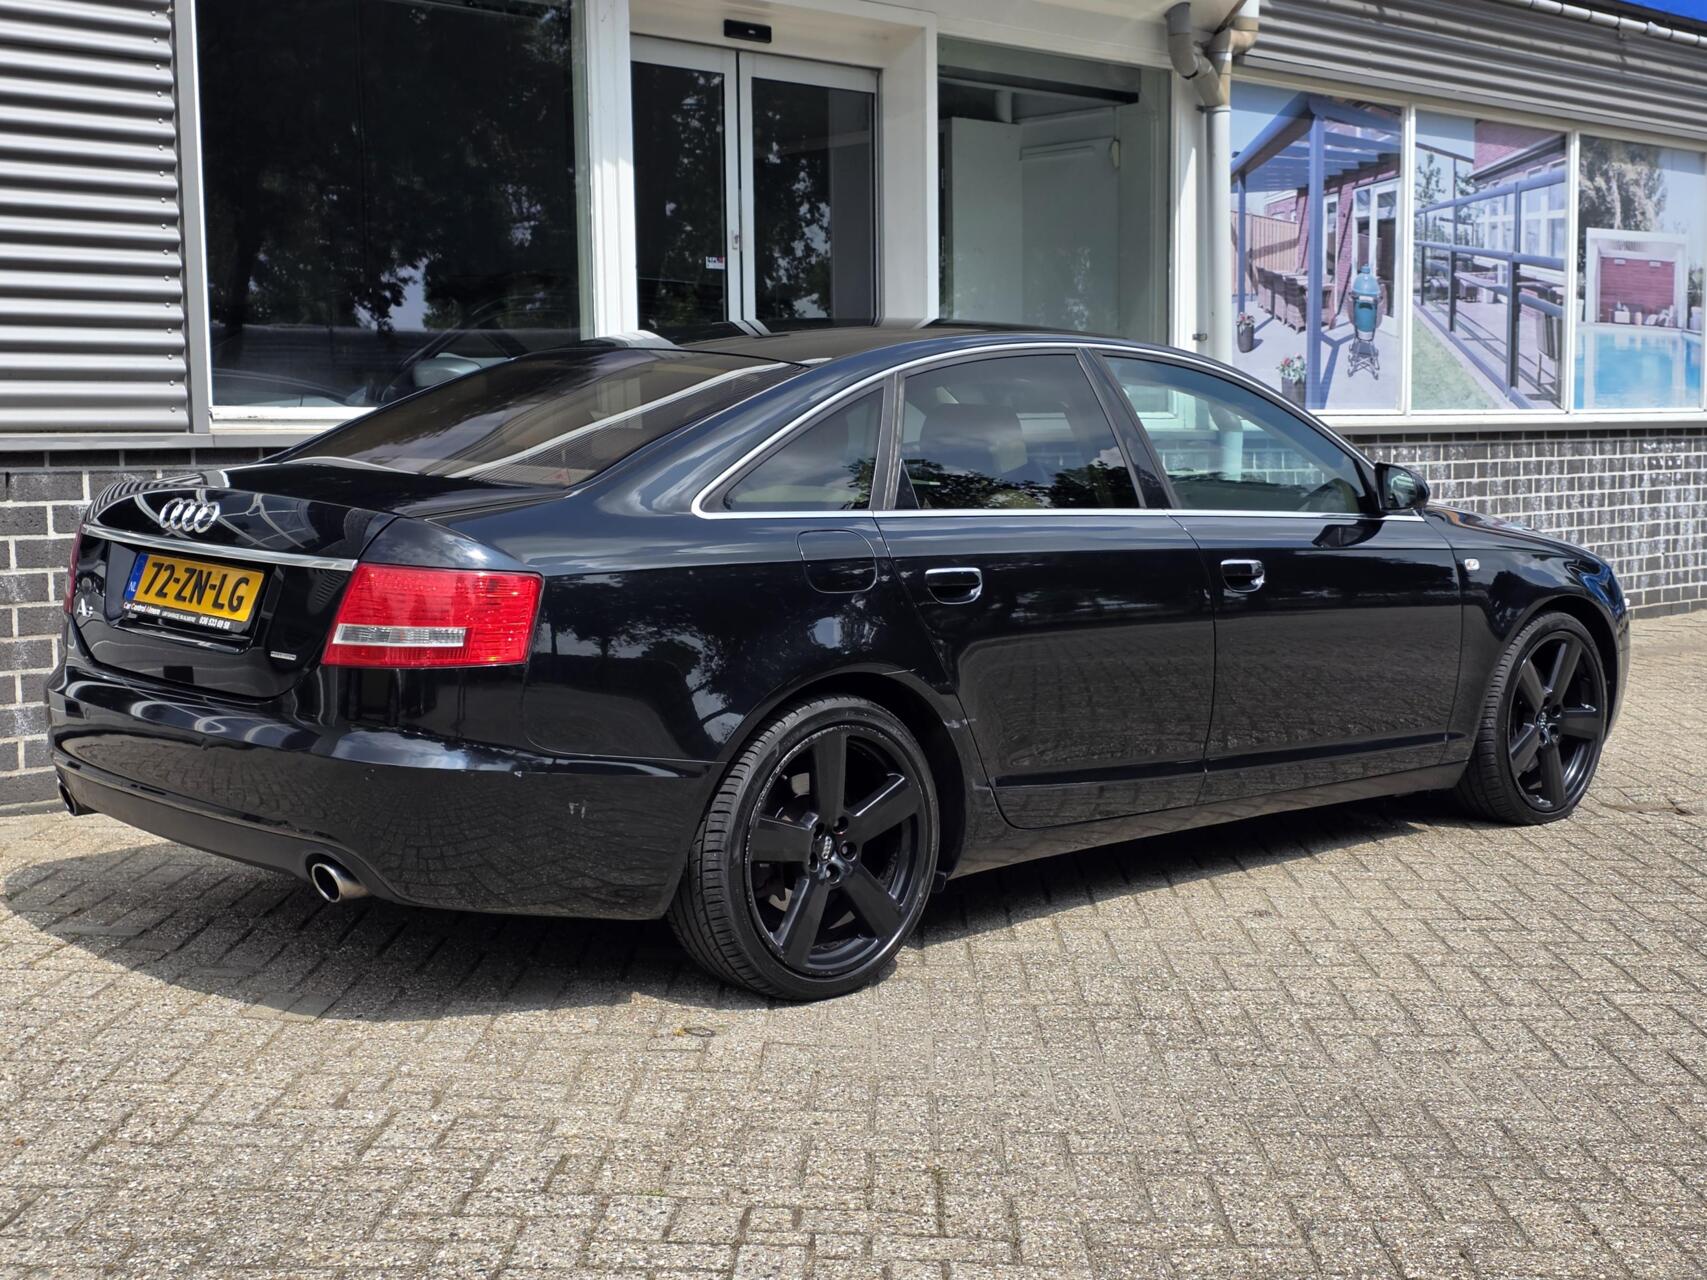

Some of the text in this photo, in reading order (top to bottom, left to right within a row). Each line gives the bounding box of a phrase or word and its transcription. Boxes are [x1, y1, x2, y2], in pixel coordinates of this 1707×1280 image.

[128, 581, 136, 593] NL
[143, 562, 250, 613] 72-ZN-LG
[77, 598, 93, 617] A6
